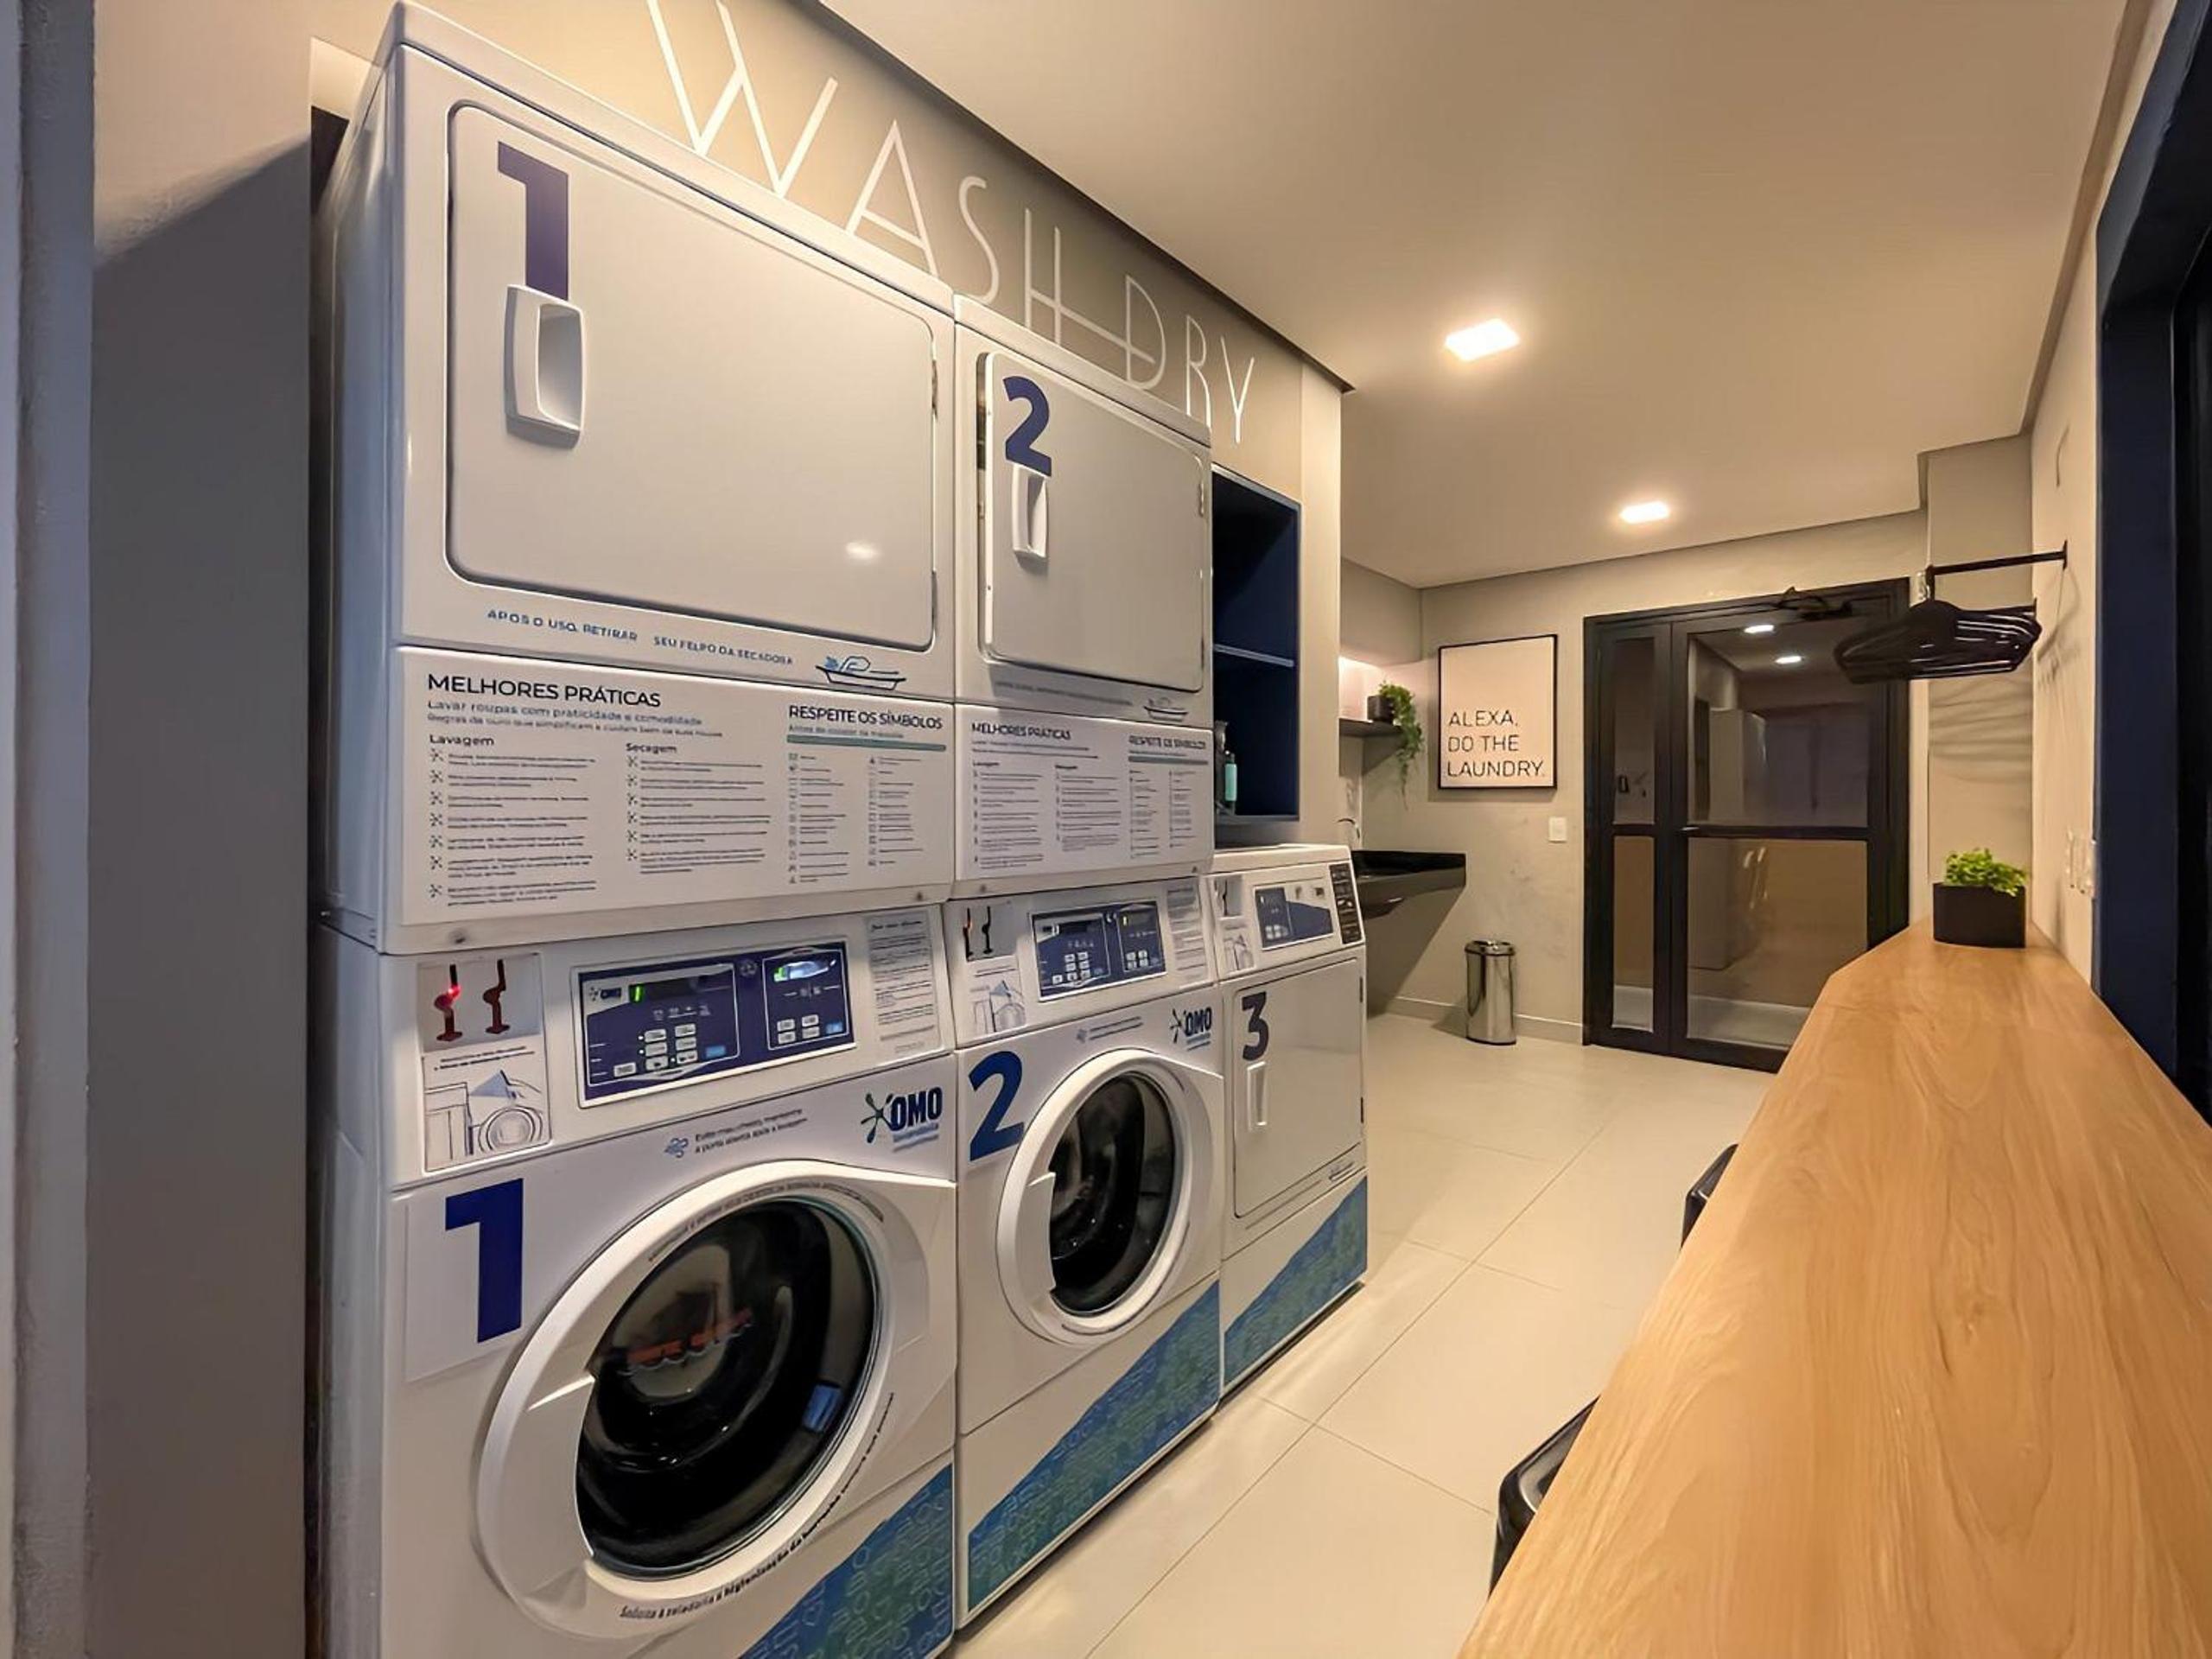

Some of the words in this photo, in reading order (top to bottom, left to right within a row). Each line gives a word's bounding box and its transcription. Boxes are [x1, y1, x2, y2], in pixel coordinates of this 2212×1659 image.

[645, 0, 1062, 347] WASH
[498, 141, 569, 302] 1
[1002, 376, 1052, 476] 2
[428, 674, 559, 699] MELHORES
[564, 683, 661, 708] PRÁTICAS
[788, 704, 857, 723] RESPEITE
[858, 711, 877, 725] OS
[429, 734, 495, 748] Lavagem
[1447, 735, 1474, 753] DO
[1482, 734, 1520, 752] THE
[1185, 1007, 1212, 1036] OMO
[1241, 991, 1269, 1062] 3
[890, 1086, 944, 1131] OMO
[968, 1051, 1025, 1161] 2
[445, 1178, 524, 1344] 1
